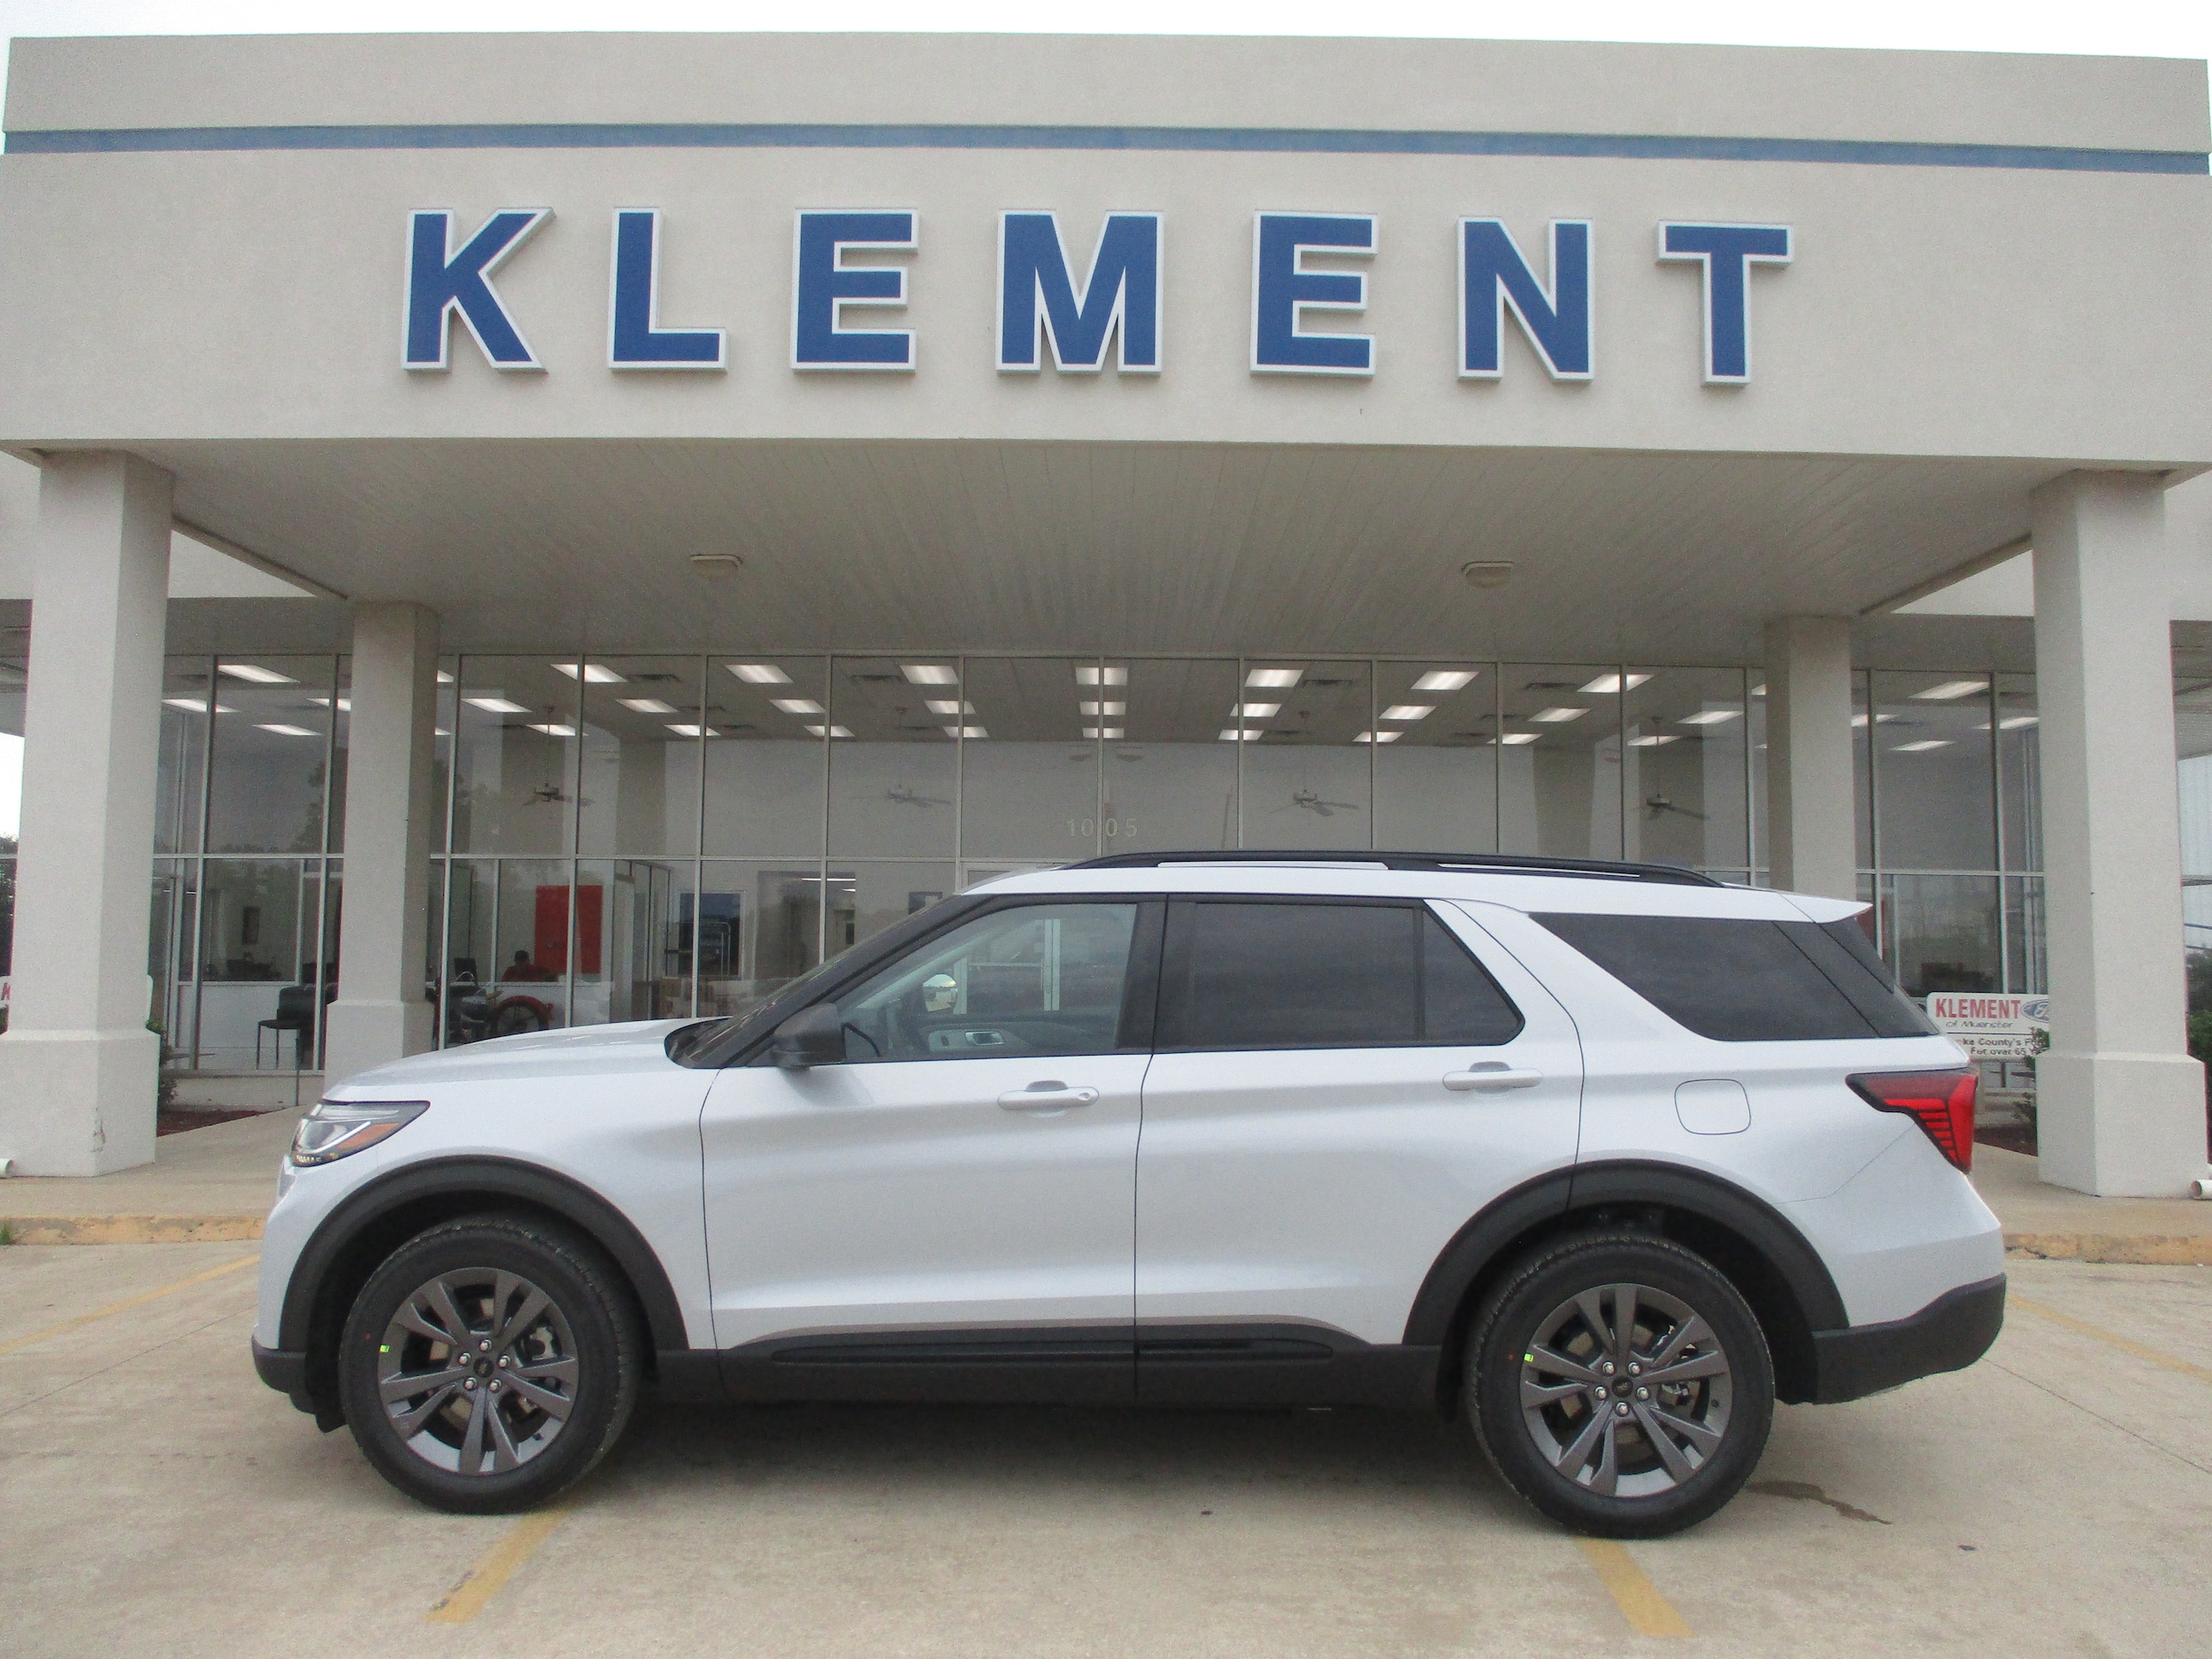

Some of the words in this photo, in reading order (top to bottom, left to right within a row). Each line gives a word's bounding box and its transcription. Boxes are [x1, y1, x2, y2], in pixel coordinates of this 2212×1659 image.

[402, 207, 1794, 384] KLEMENT
[1067, 818, 1138, 838] 1005
[1935, 998, 2021, 1018] KLEMENT
[1978, 1037, 2022, 1048] County's
